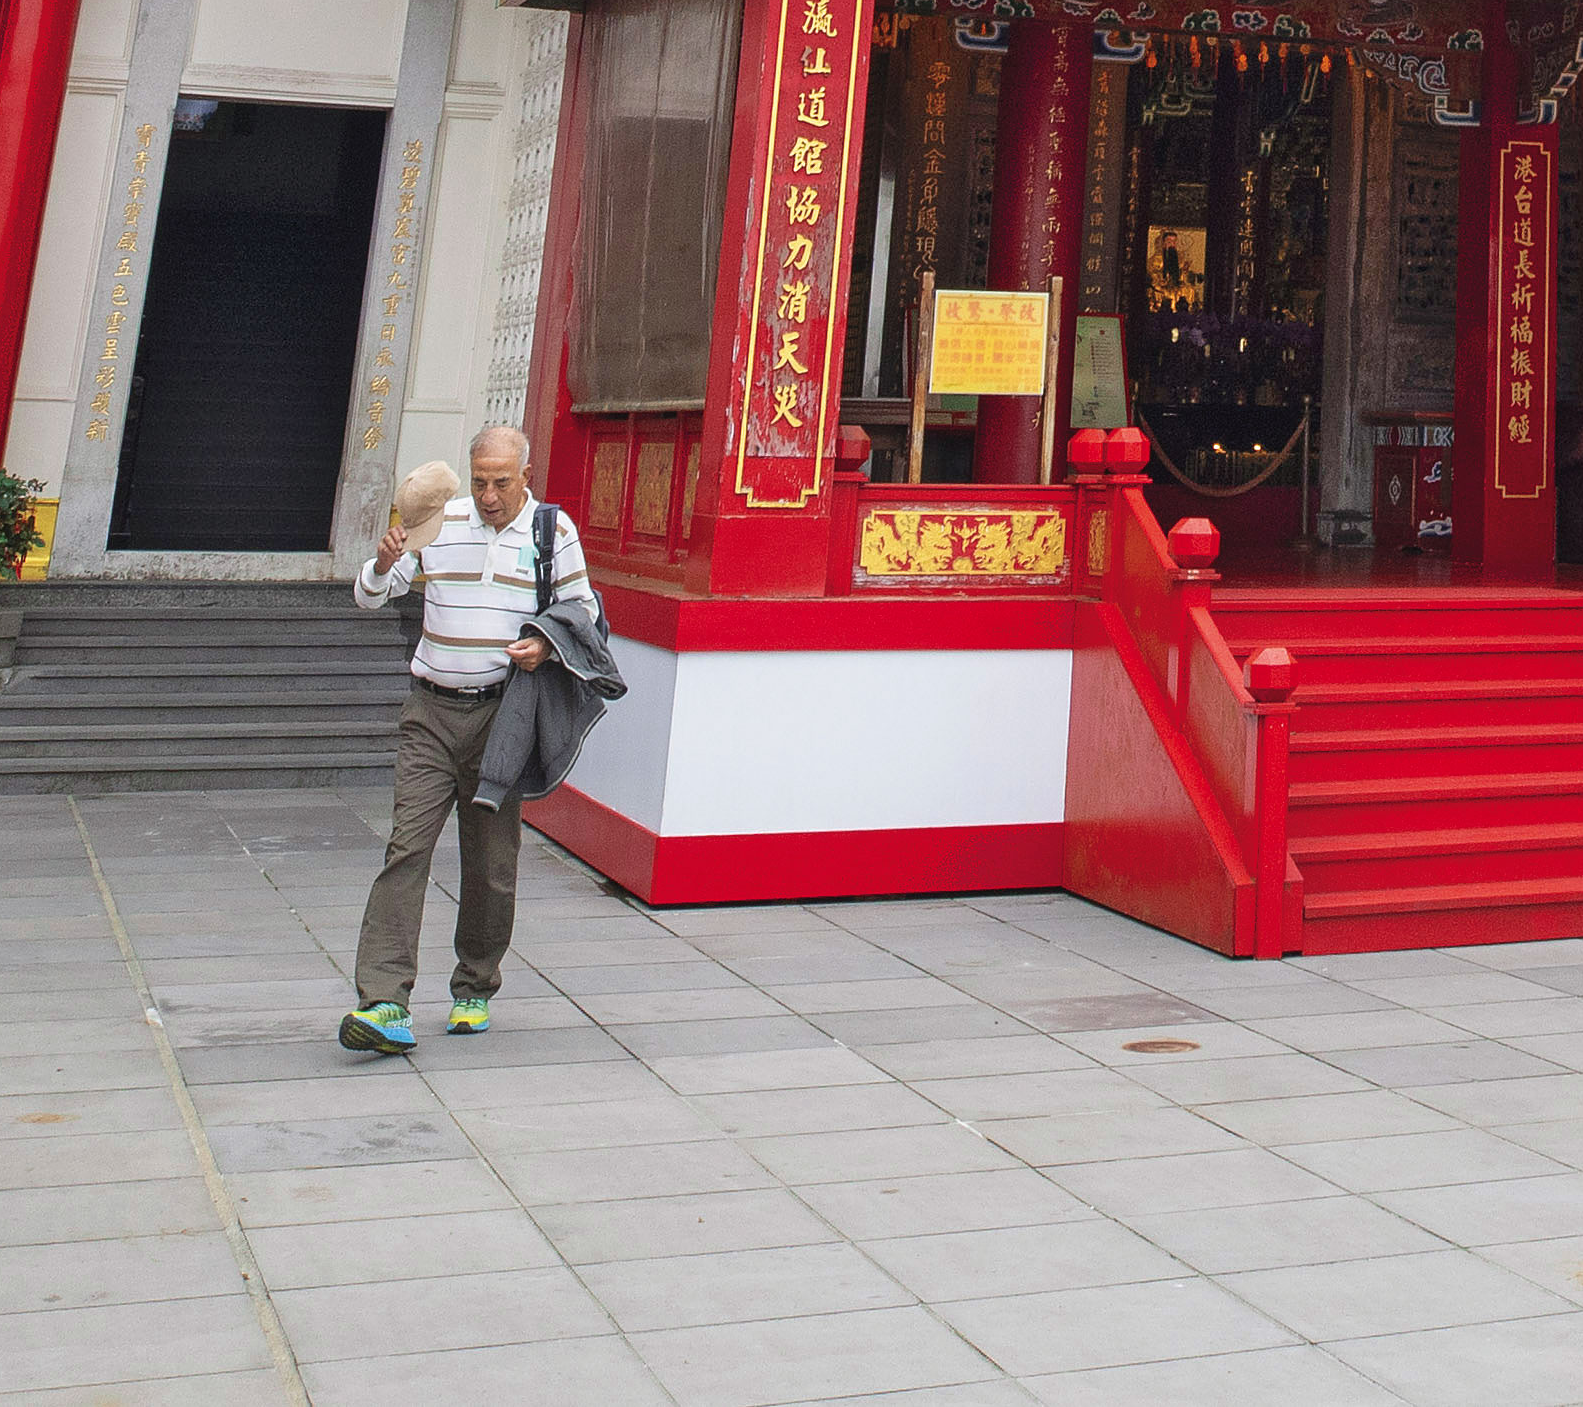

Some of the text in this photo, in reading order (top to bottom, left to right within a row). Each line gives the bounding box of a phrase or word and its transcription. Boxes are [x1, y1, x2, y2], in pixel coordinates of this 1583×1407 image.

[1507, 156, 1538, 444] 港台道長祈福振財經
